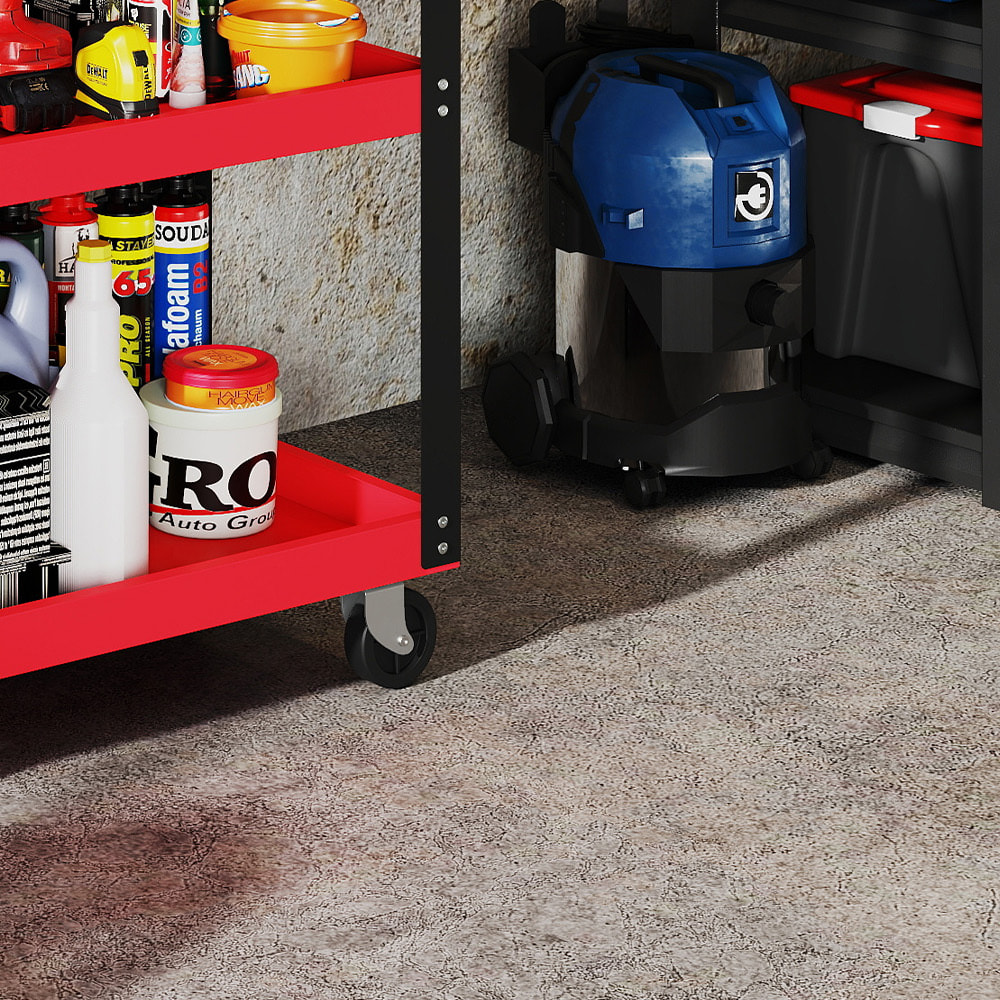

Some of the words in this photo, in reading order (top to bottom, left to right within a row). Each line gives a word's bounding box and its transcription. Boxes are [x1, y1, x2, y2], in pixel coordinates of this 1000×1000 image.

[233, 64, 270, 90] ANG
[115, 235, 155, 251] STAYE
[192, 259, 208, 294] B2
[119, 314, 142, 387] PRO
[217, 394, 265, 406] MOVE
[158, 512, 217, 531] Auto
